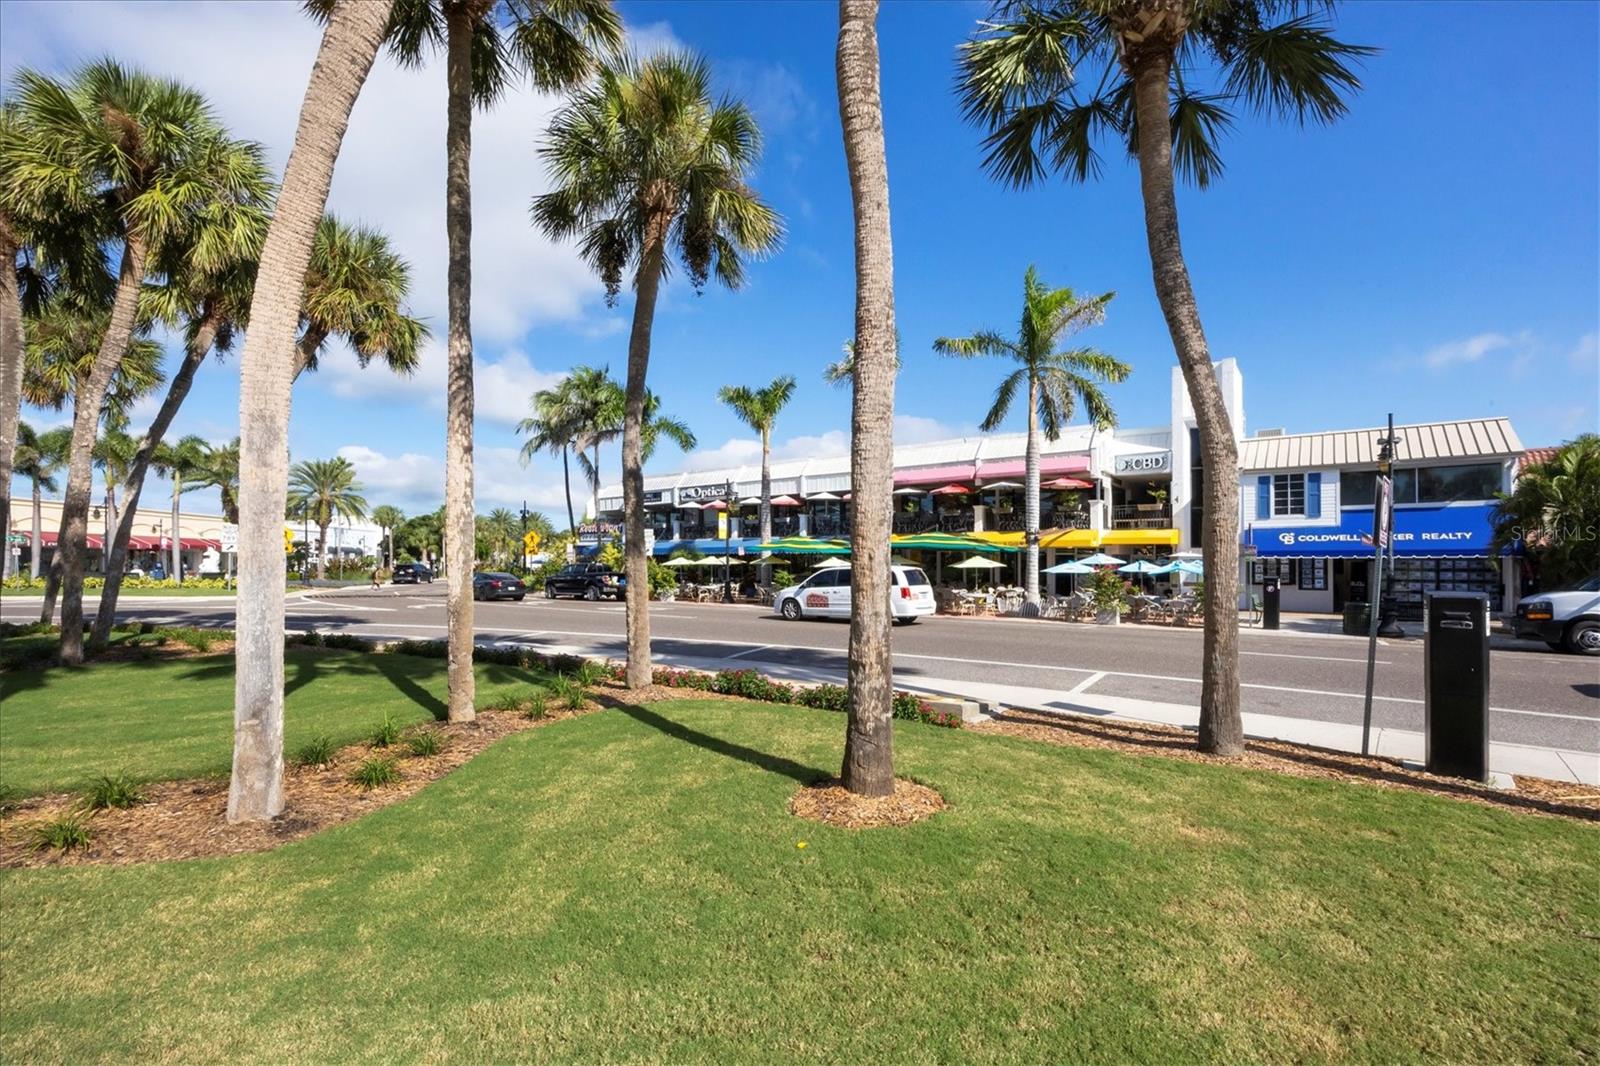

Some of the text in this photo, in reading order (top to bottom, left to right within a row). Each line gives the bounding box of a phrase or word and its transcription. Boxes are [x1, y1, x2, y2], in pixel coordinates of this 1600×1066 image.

[1132, 456, 1164, 470] CBD
[1298, 533, 1362, 542] COLDWELL
[1421, 532, 1473, 541] REALTY
